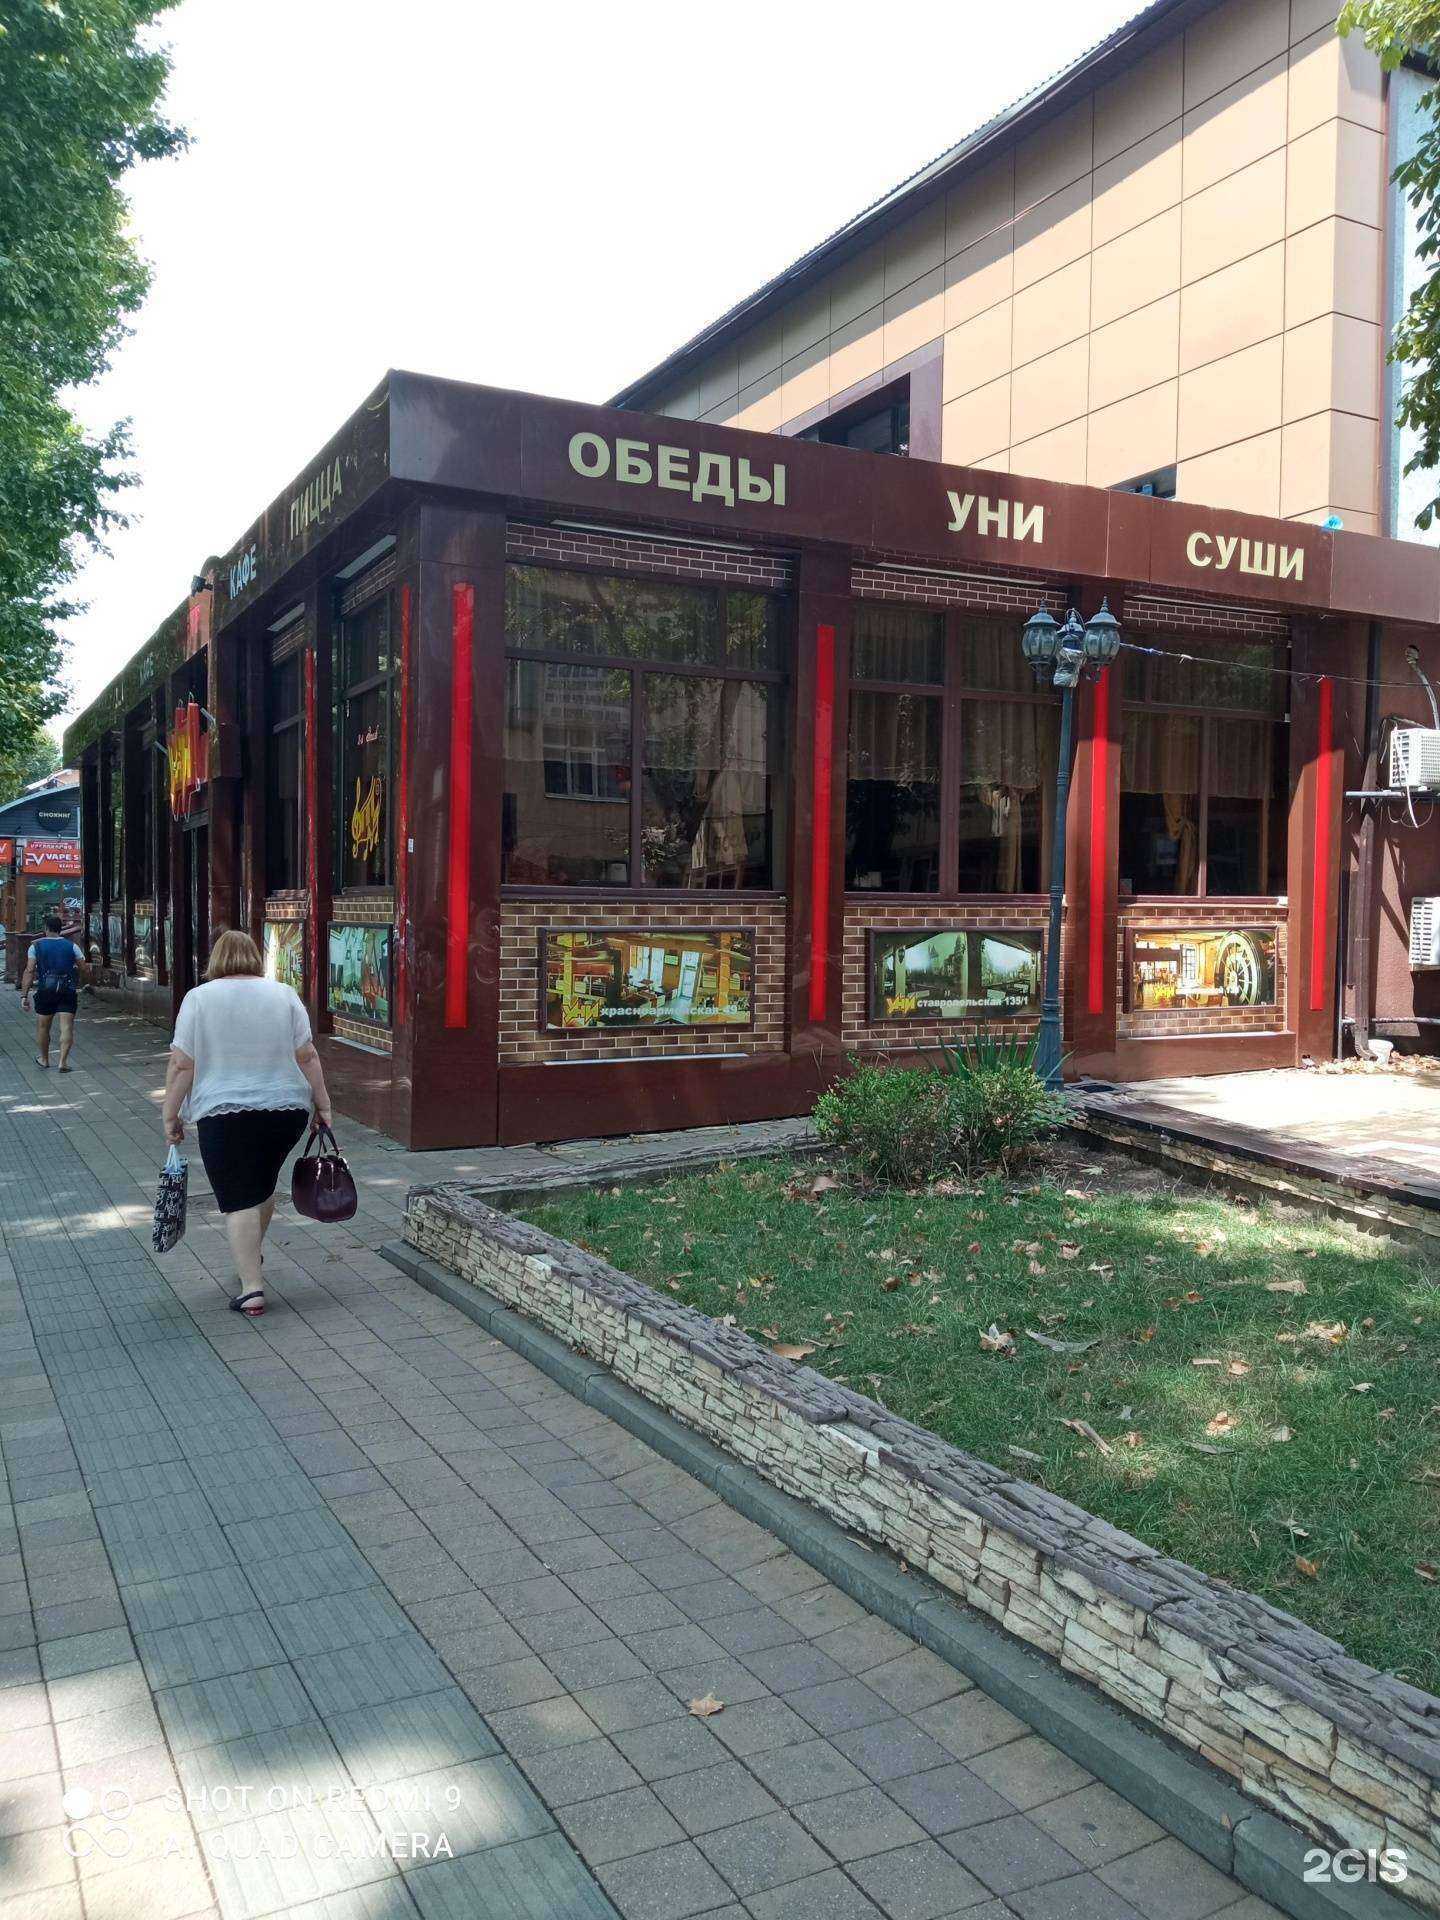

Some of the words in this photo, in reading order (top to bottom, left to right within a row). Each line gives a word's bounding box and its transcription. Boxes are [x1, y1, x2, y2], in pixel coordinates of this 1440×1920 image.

[568, 431, 786, 507] ОБЕДЫ
[290, 456, 343, 541] ПИЦЦА
[946, 490, 1044, 544] УНИ
[229, 543, 257, 600] КАФЕ
[1186, 531, 1305, 581] СУШИ
[45, 853, 72, 861] VAPE
[1004, 996, 1028, 1007] 135/1
